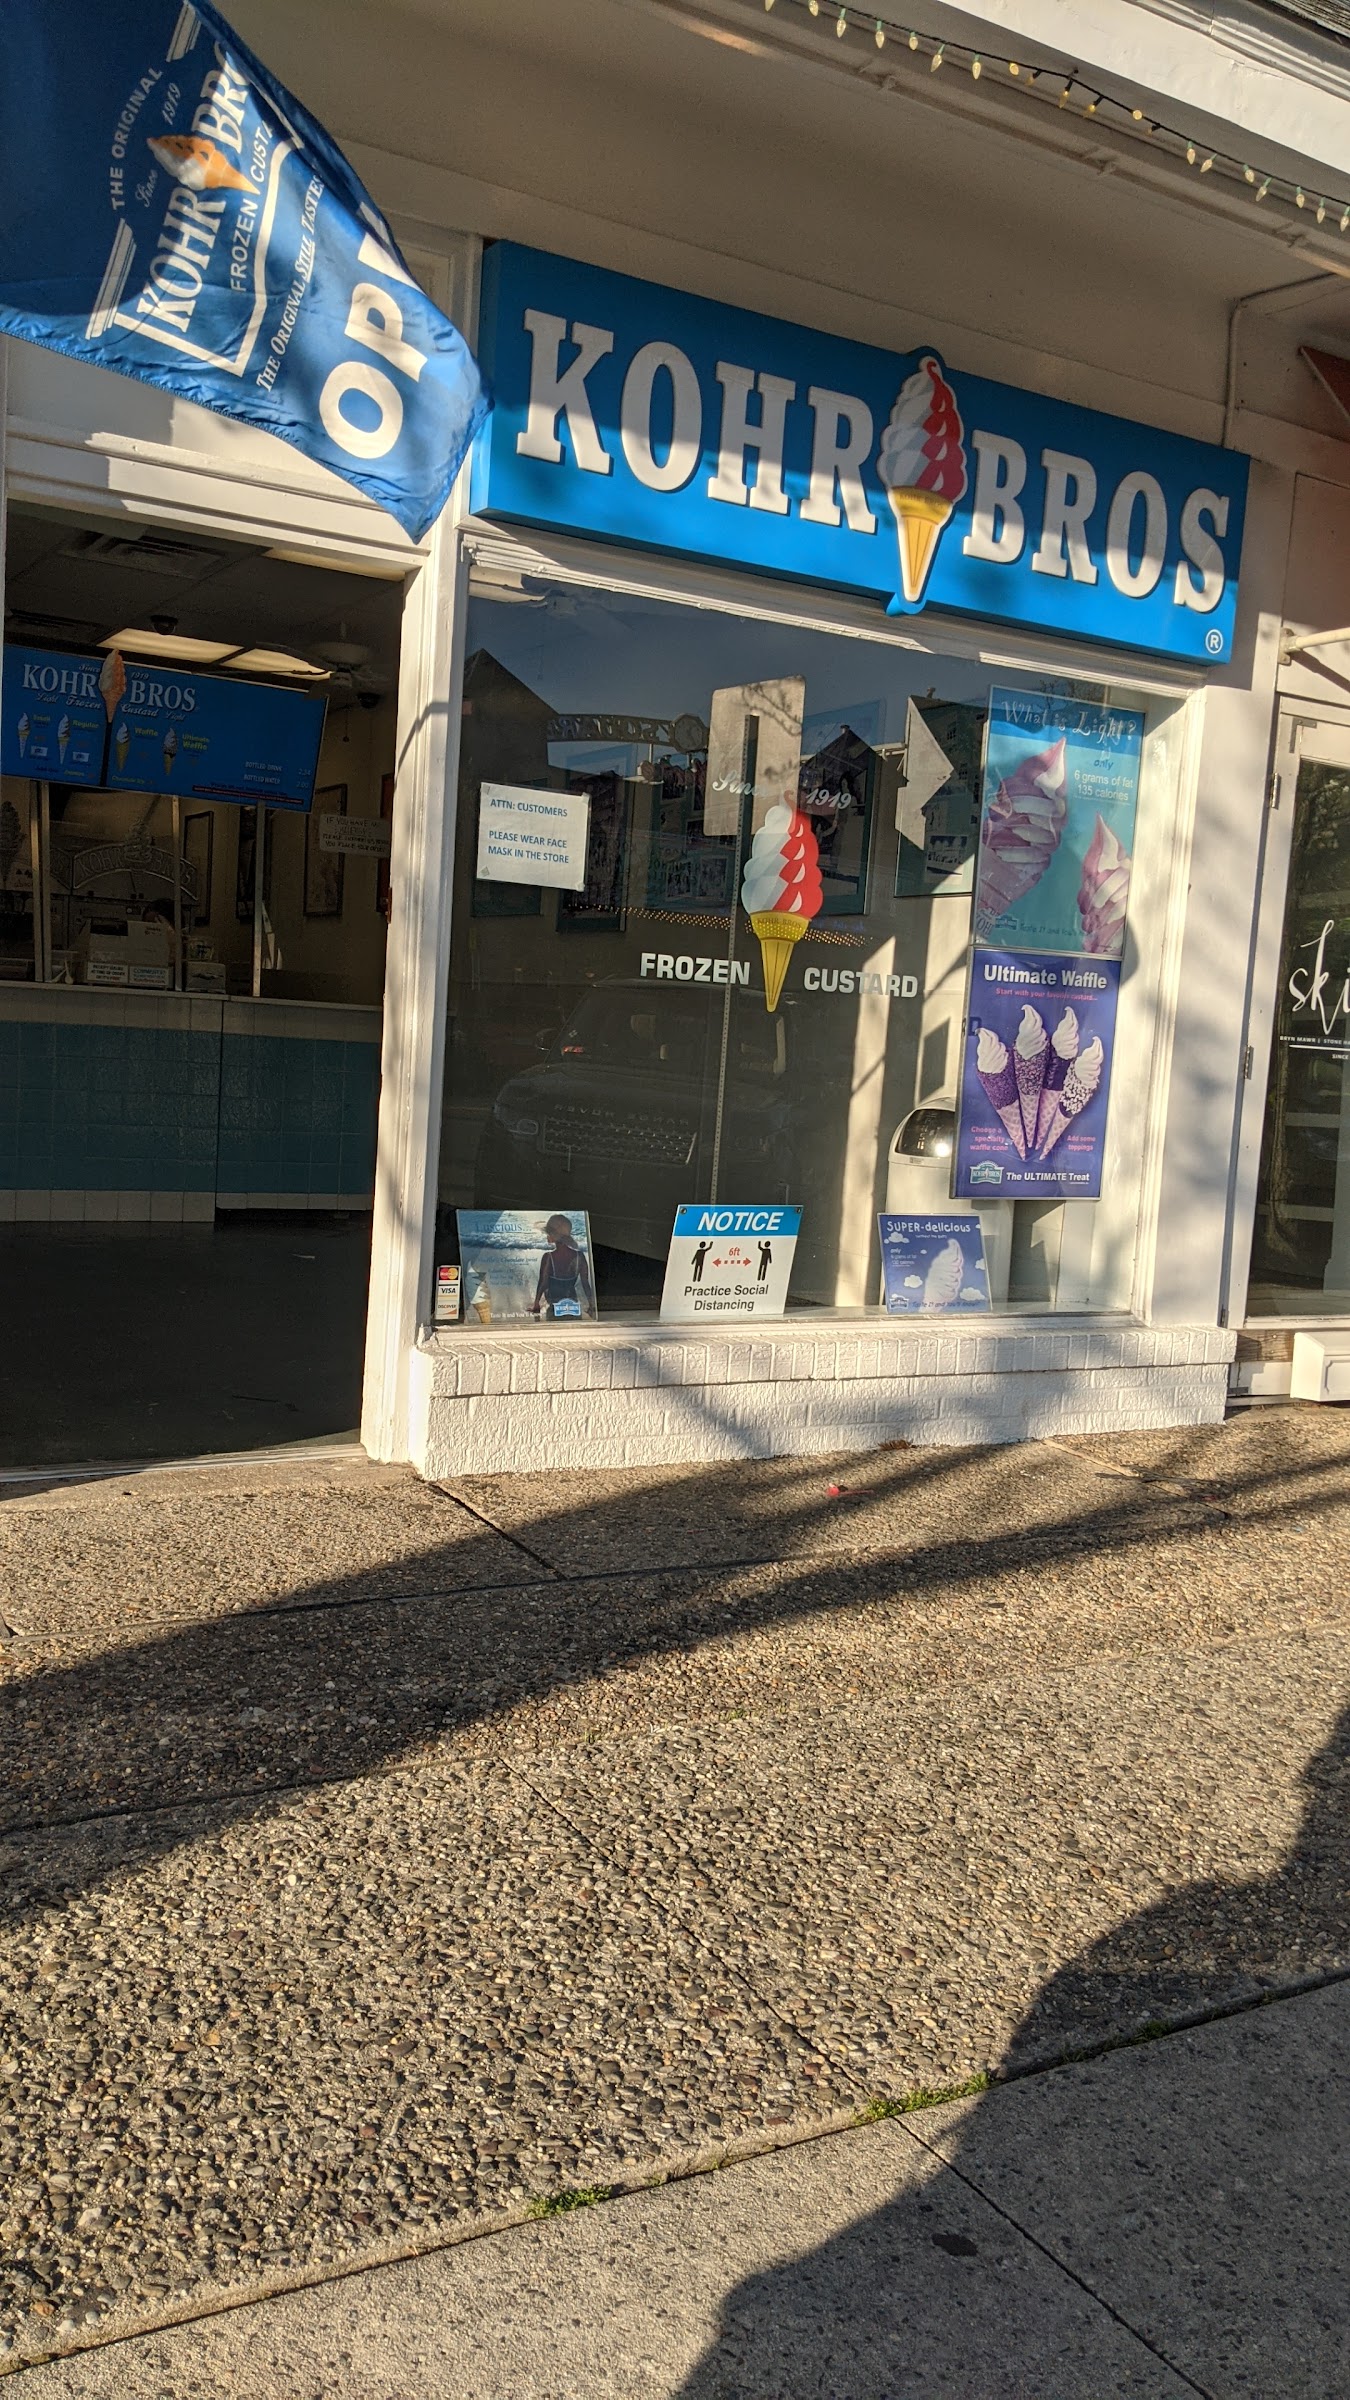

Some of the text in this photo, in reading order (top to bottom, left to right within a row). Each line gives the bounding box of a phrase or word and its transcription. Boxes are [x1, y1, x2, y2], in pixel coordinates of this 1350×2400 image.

[161, 82, 181, 126] 1919
[109, 66, 163, 211] THE ORIGINAL
[230, 198, 260, 292] FROZEN
[136, 186, 227, 333] KOHR
[256, 355, 281, 392] THE
[270, 279, 306, 356] ORIGINAL
[294, 235, 316, 284] STILL
[516, 307, 877, 535] KOHR
[962, 429, 1231, 615] BROS
[22, 663, 197, 712] KOHR BROS
[65, 695, 102, 710] Frozen
[120, 703, 159, 718] Custard
[1002, 700, 1048, 726] What
[1054, 713, 1066, 732] is
[1093, 759, 1114, 771] only
[1074, 769, 1134, 788] 6 grams of fat
[712, 770, 852, 810] Sin 1919
[1077, 784, 1093, 796] 135
[1094, 786, 1129, 802] calories
[490, 798, 568, 817] ATTN: CUSTOMERS
[488, 830, 568, 849] PLEASE WEAR FACE
[488, 845, 569, 864] MASK IN THE STORE
[757, 917, 802, 929] KOHR BROS
[640, 952, 918, 998] FROZEN CUSTARD
[983, 964, 1108, 989] Ultimate Waffle
[995, 987, 1014, 996] Start
[1014, 988, 1030, 998] with
[1030, 990, 1046, 1000] your
[971, 1126, 997, 1135] Choose
[974, 1136, 1006, 1144] specialty
[969, 1143, 991, 1151] waffle
[1068, 1144, 1095, 1152] toppings
[1006, 1172, 1090, 1181] The ULTIMATE Treat
[697, 1211, 784, 1232] NOTICE
[886, 1220, 972, 1233] SUPER-delicious
[728, 1246, 740, 1256] 6ft
[684, 1284, 769, 1297] Practice Social
[694, 1299, 755, 1312] Distancing
